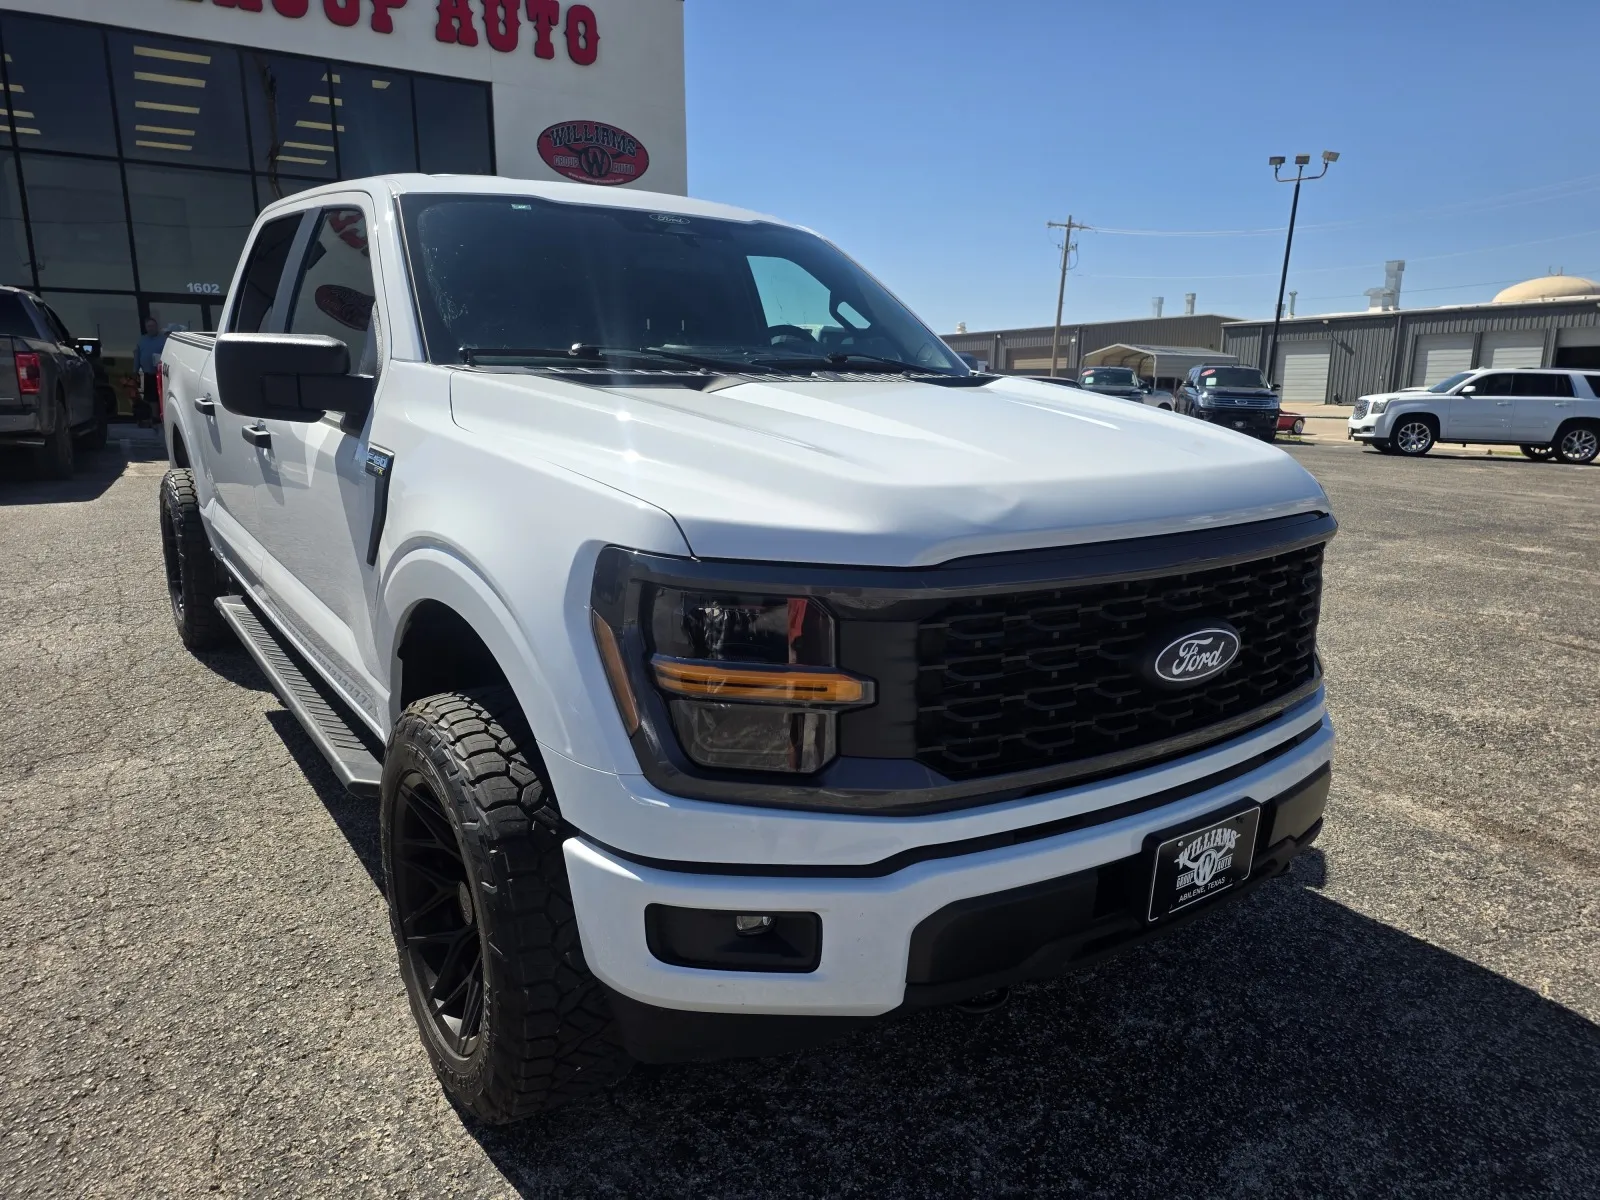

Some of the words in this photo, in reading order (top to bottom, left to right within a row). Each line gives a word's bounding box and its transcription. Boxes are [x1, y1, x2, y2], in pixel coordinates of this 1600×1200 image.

[435, 0, 600, 66] AUTO
[550, 124, 636, 157] WILLIAMS
[553, 155, 580, 168] GROUP
[611, 162, 635, 175] AUTO
[186, 282, 221, 294] 1602
[1172, 637, 1225, 675] Ford
[1178, 828, 1237, 869] WILLIAMS
[1178, 886, 1206, 902] ABILENE,
[1207, 876, 1225, 889] TEXAS
